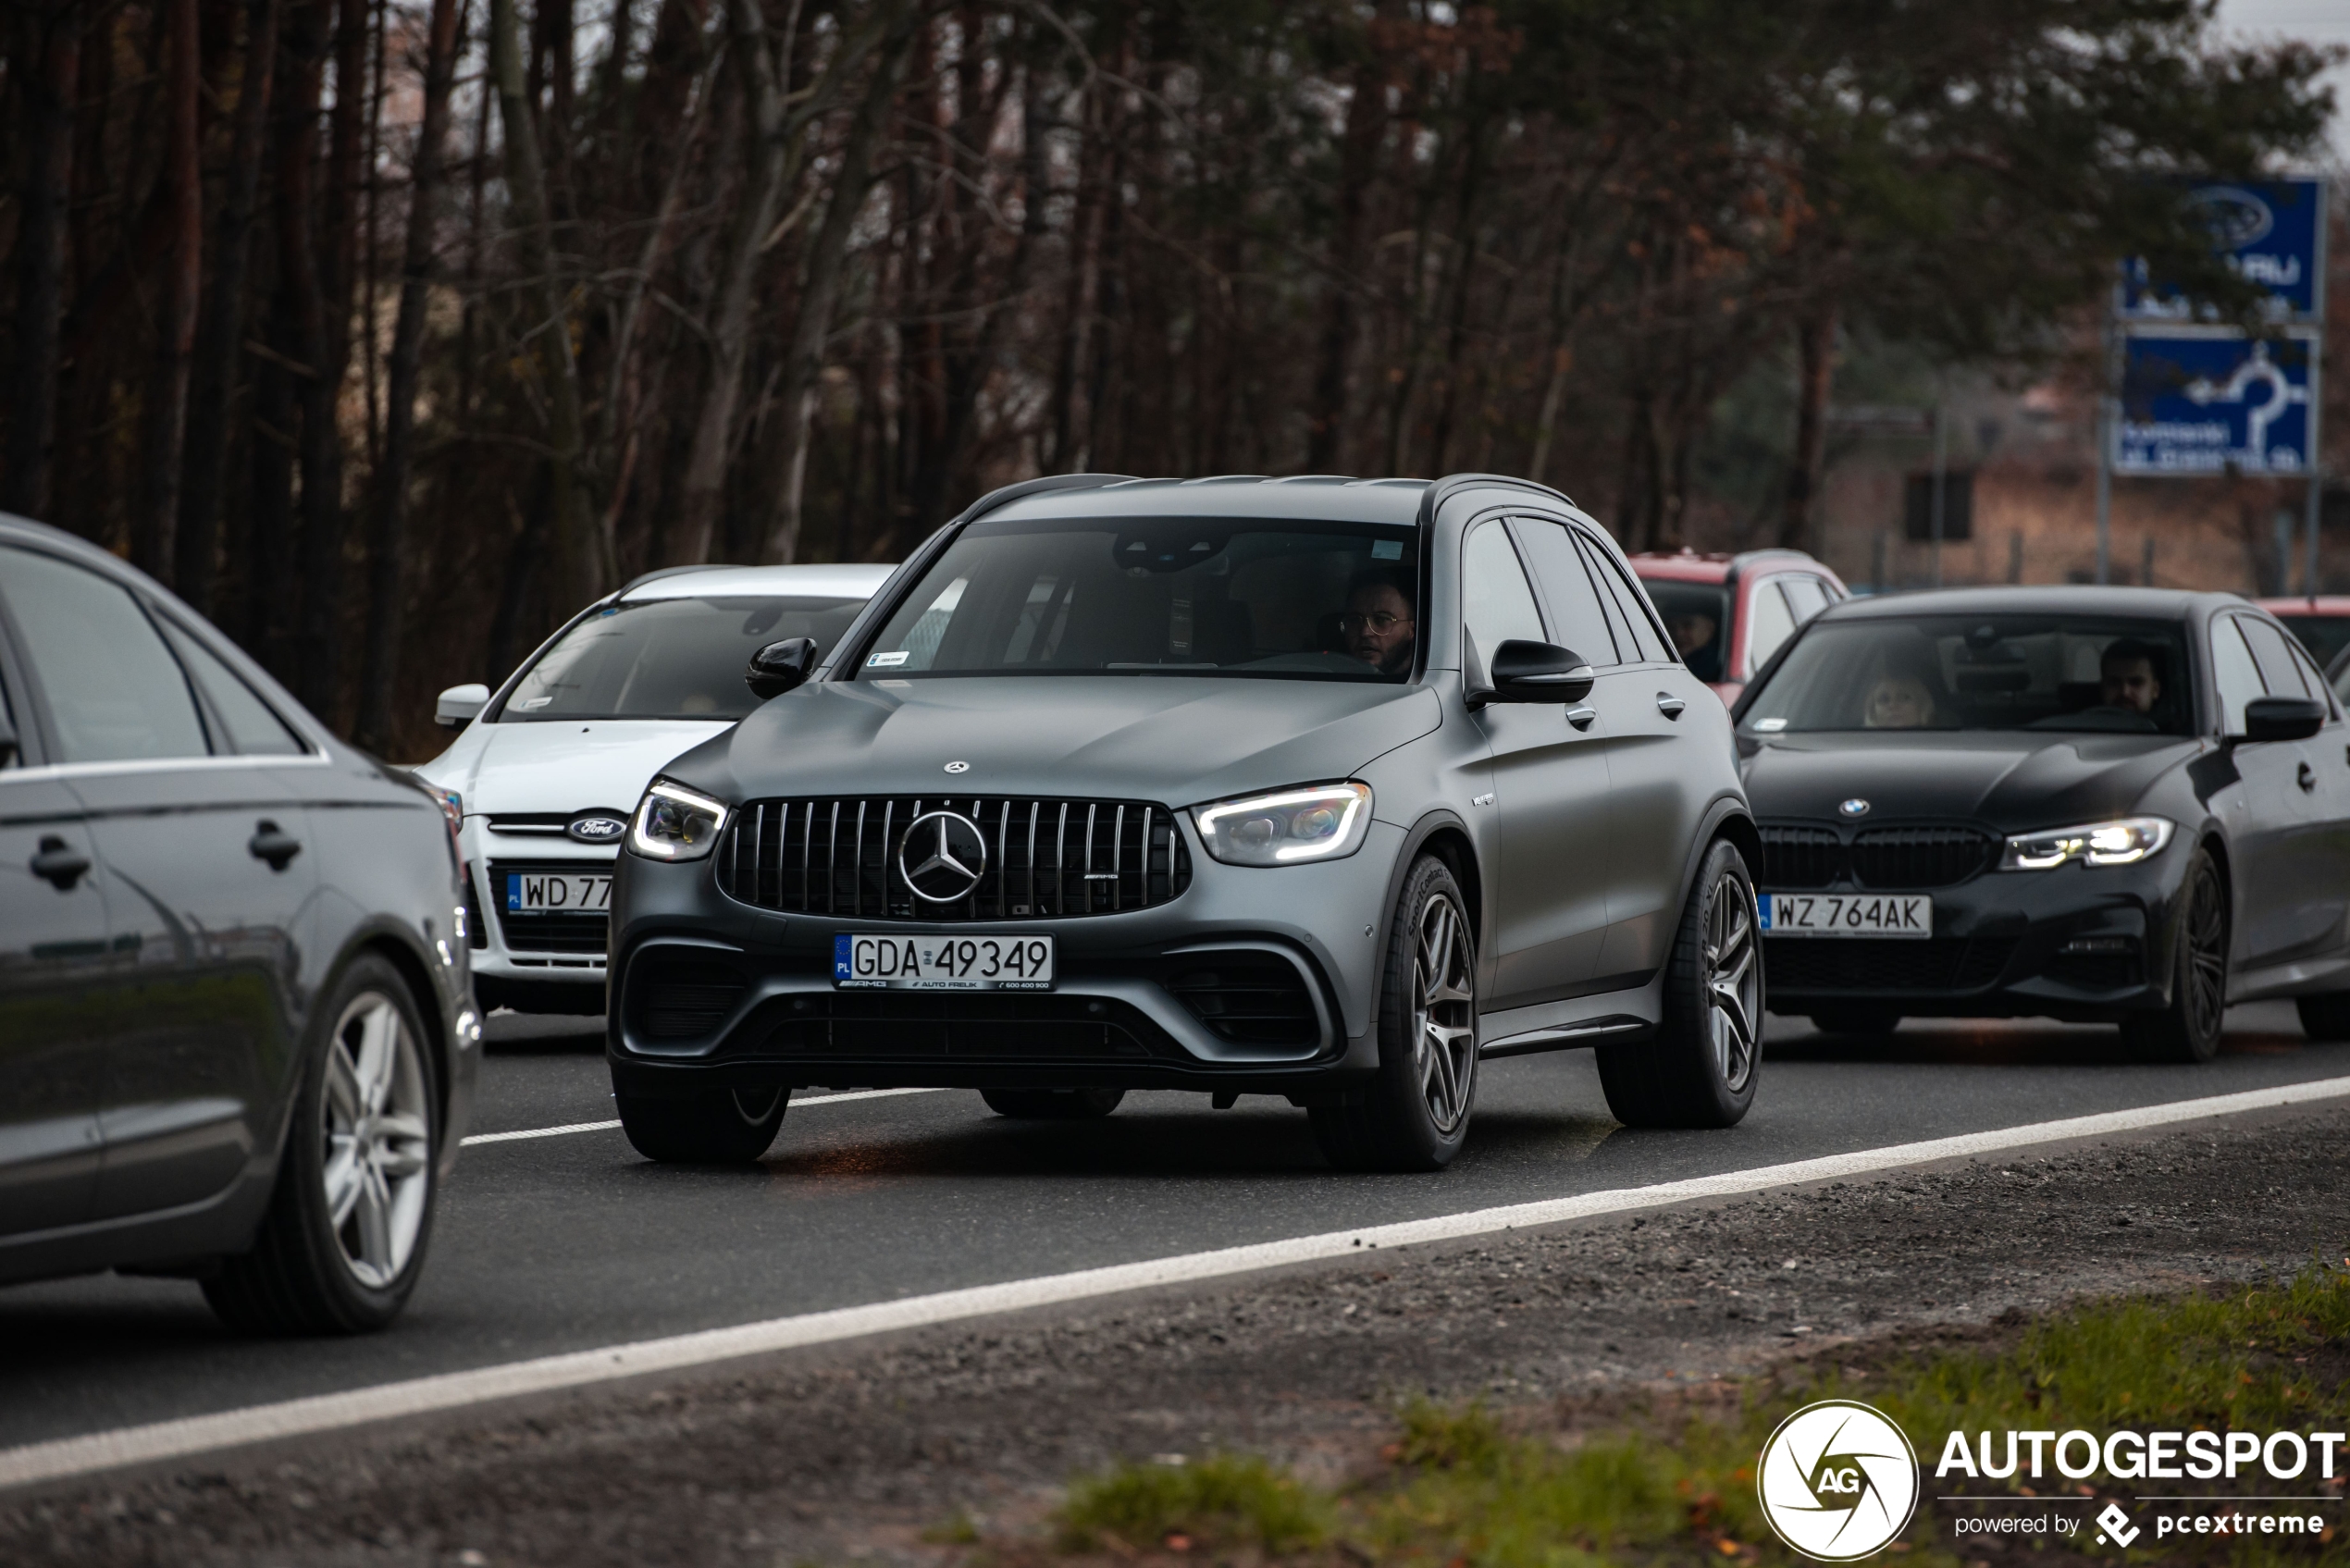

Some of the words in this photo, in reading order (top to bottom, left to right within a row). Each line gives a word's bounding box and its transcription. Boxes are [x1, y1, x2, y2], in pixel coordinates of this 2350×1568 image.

[581, 821, 613, 834] Ford
[510, 895, 519, 903] PL
[526, 877, 568, 907] WD
[578, 878, 612, 907] 77
[1408, 867, 1443, 940] SportContact
[1777, 897, 1815, 927] WZ
[1827, 897, 1922, 929] 764AK
[837, 963, 849, 973] PL
[855, 939, 921, 976] GDA
[934, 940, 1047, 977] 49349
